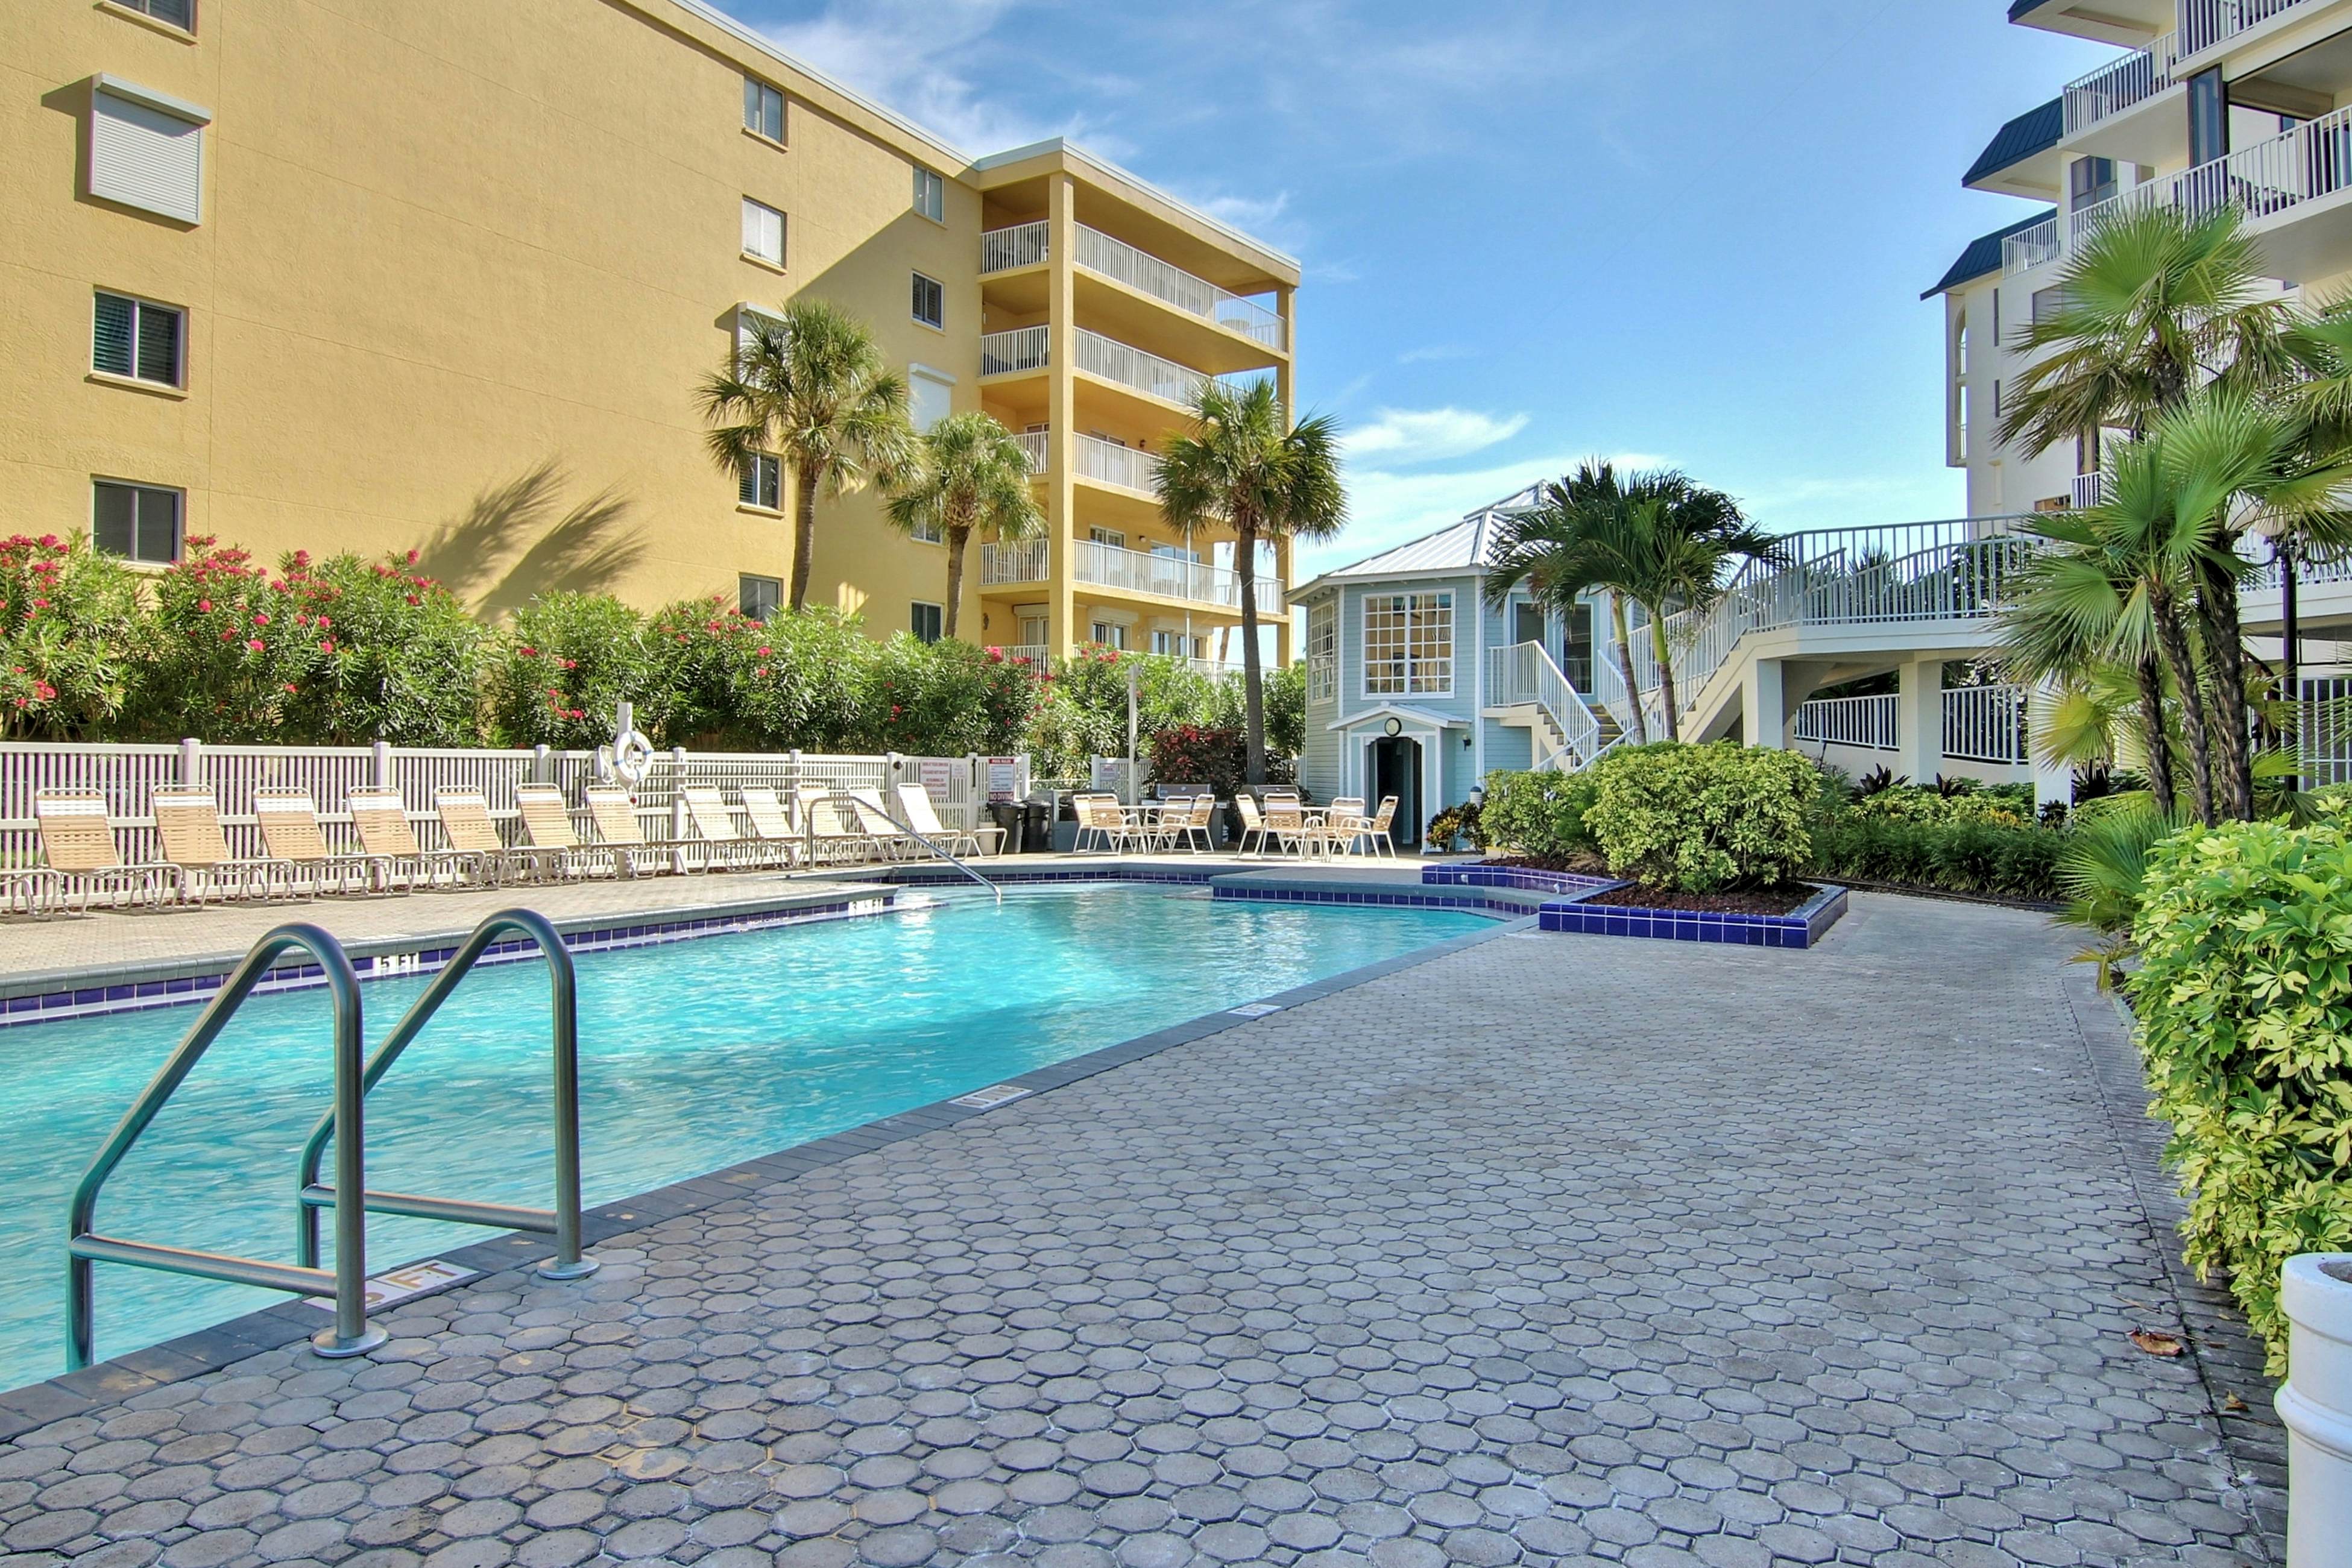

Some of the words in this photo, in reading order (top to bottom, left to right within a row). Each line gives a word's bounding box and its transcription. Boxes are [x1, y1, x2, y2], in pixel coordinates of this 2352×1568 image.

[380, 956, 390, 968] 5
[398, 952, 417, 966] FT
[386, 1263, 458, 1288] FT
